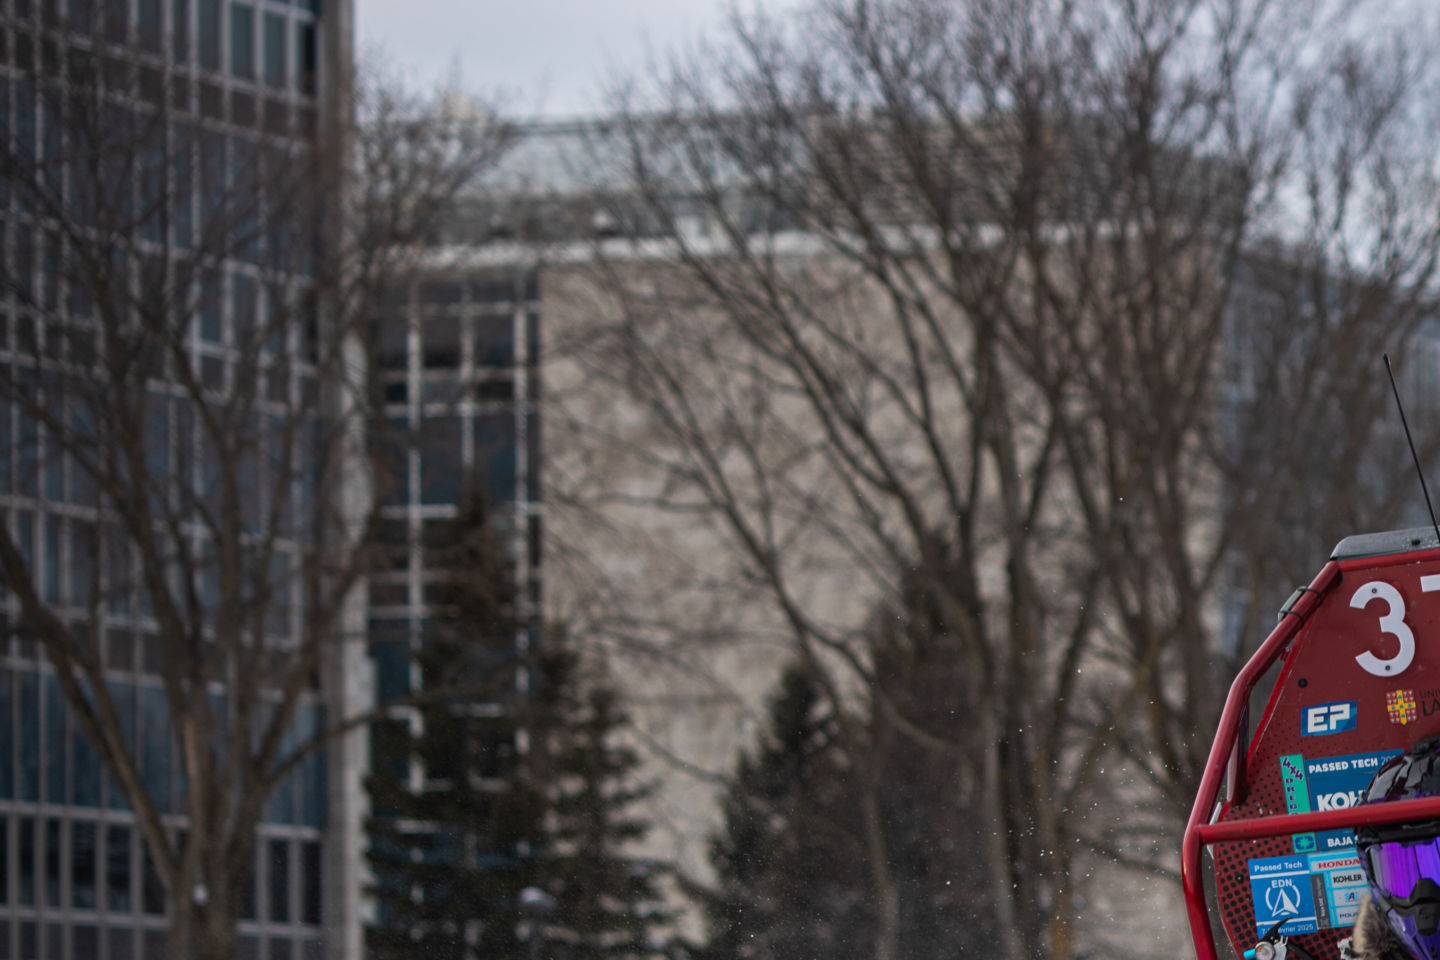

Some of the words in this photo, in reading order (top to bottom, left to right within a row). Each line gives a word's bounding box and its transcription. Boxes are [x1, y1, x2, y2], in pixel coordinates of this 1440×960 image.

[1307, 703, 1351, 733] EP
[1308, 761, 1349, 774] PASSED
[1352, 757, 1378, 769] TECH
[1327, 836, 1353, 848] BAJA
[1254, 862, 1282, 873] Passed
[1284, 860, 1302, 871] Tech
[1318, 857, 1360, 870] HONDA
[1271, 879, 1292, 888] EDN
[1332, 874, 1363, 884] KOHLER
